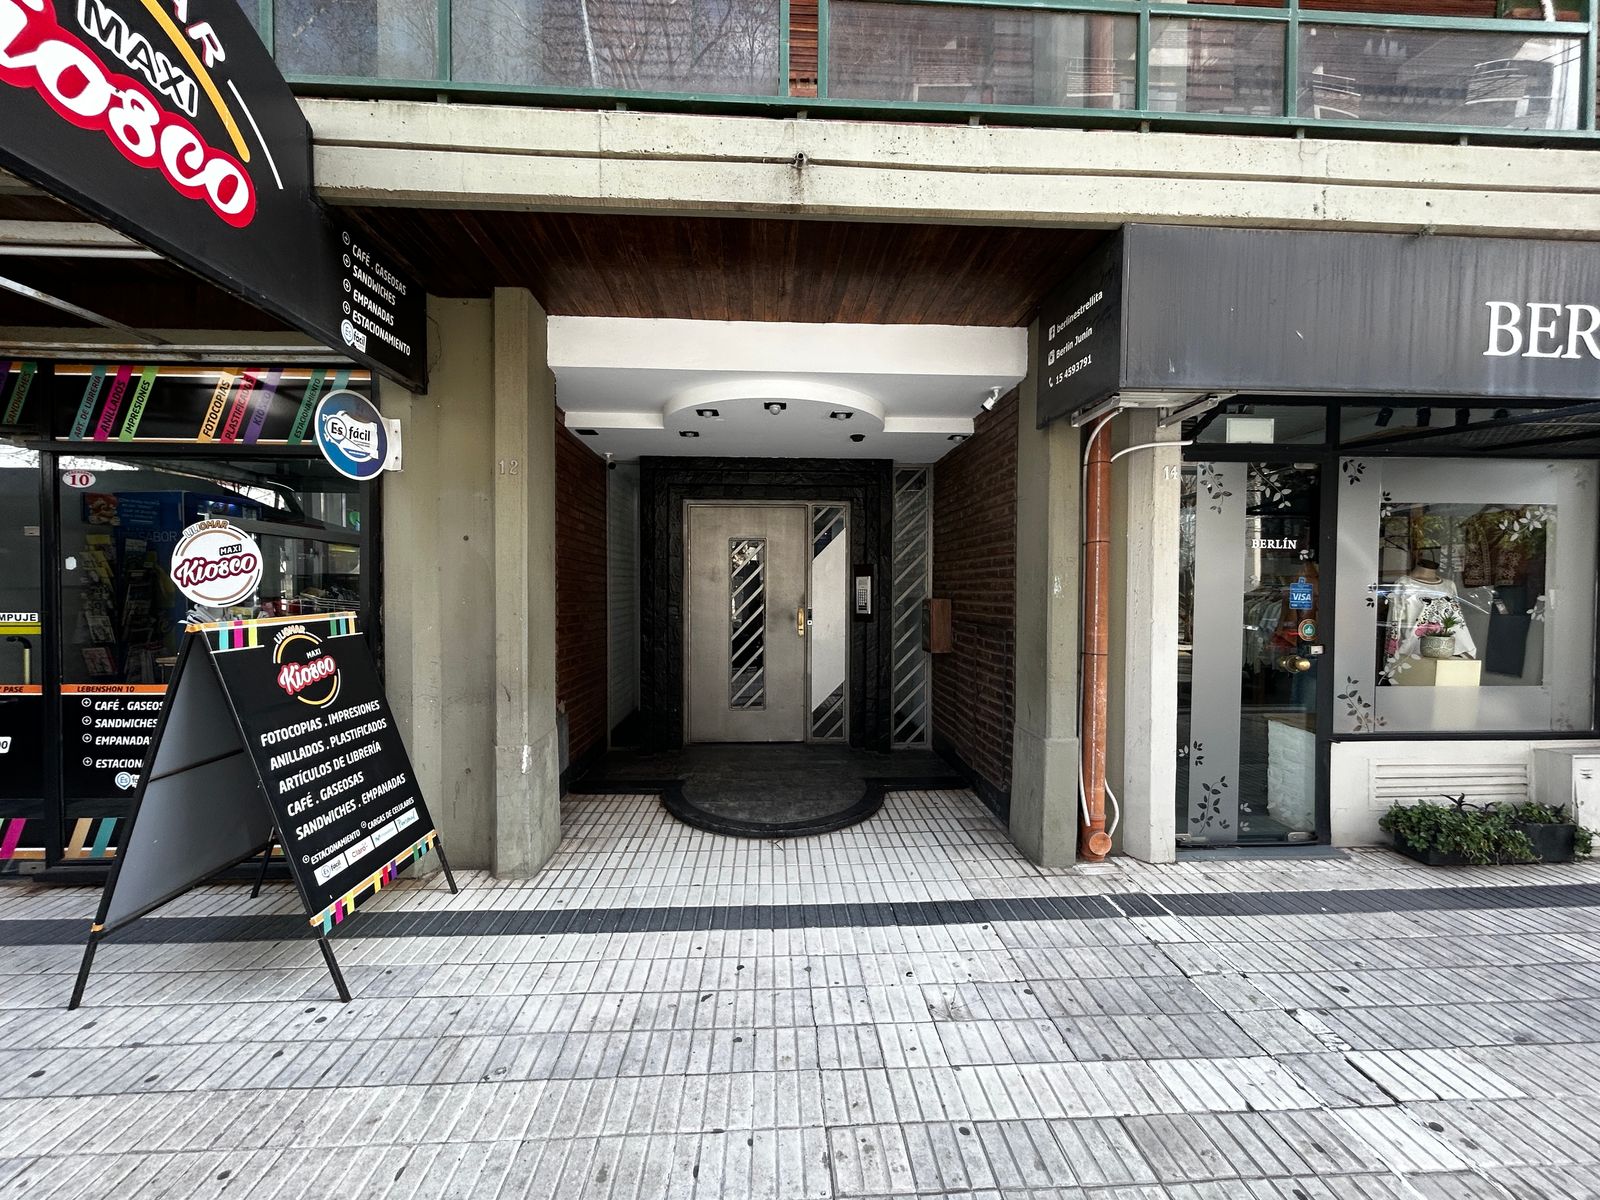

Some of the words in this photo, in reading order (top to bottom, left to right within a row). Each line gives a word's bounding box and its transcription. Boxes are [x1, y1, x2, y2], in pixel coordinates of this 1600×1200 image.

[77, 0, 199, 117] MAXI
[352, 244, 370, 267] CAFÉ
[375, 262, 407, 296] GASEOSAS
[352, 265, 396, 306] SANDWICHES
[353, 289, 394, 326] EMPANADAS
[1056, 291, 1103, 333] berlinestrellita
[352, 310, 411, 356] ESTACIONAMIENTO
[1482, 301, 1600, 360] BER
[1055, 372, 1063, 385] 15
[1063, 354, 1093, 378] 4593791
[81, 408, 90, 420] DE
[100, 380, 126, 433] ANILLADOS
[125, 380, 150, 435] IMPRESIONES
[203, 379, 231, 437] FOTOCOPIAS
[225, 376, 255, 441] PLASTIFICADOS
[294, 378, 321, 440] ESTACIONAMIENTO
[331, 422, 344, 436] Es
[349, 426, 371, 441] fácil
[70, 474, 90, 486] 10
[499, 459, 518, 475] 12
[1163, 465, 1178, 480] 14
[220, 545, 241, 556] MAXI
[1251, 537, 1297, 550] BERLÍN
[175, 554, 257, 587] Kiosco
[1292, 592, 1312, 601] VISA
[306, 648, 322, 659] MAXI
[279, 657, 336, 693] Kiosco
[95, 699, 120, 711] CAFÉ
[260, 717, 323, 747] FOTOCOPIAS
[328, 700, 380, 725] IMPRESIONES
[95, 736, 152, 746] EMPANADA
[270, 740, 325, 771] ANILLADOS
[330, 718, 387, 747] PLASTIFICADOS
[279, 761, 333, 794] ARTÍCULOS
[333, 756, 346, 771] DE
[346, 741, 382, 764] LIBRERÍA
[287, 792, 314, 817] CAFÉ
[320, 771, 364, 801] GASEOSAS
[296, 799, 357, 841] SANDWICHES
[361, 773, 406, 805] EMPANADAS
[367, 814, 385, 830] CARGAS
[385, 810, 392, 819] DE
[392, 797, 415, 815] CELULARES
[310, 829, 361, 865] ESTACIONAMIENTO
